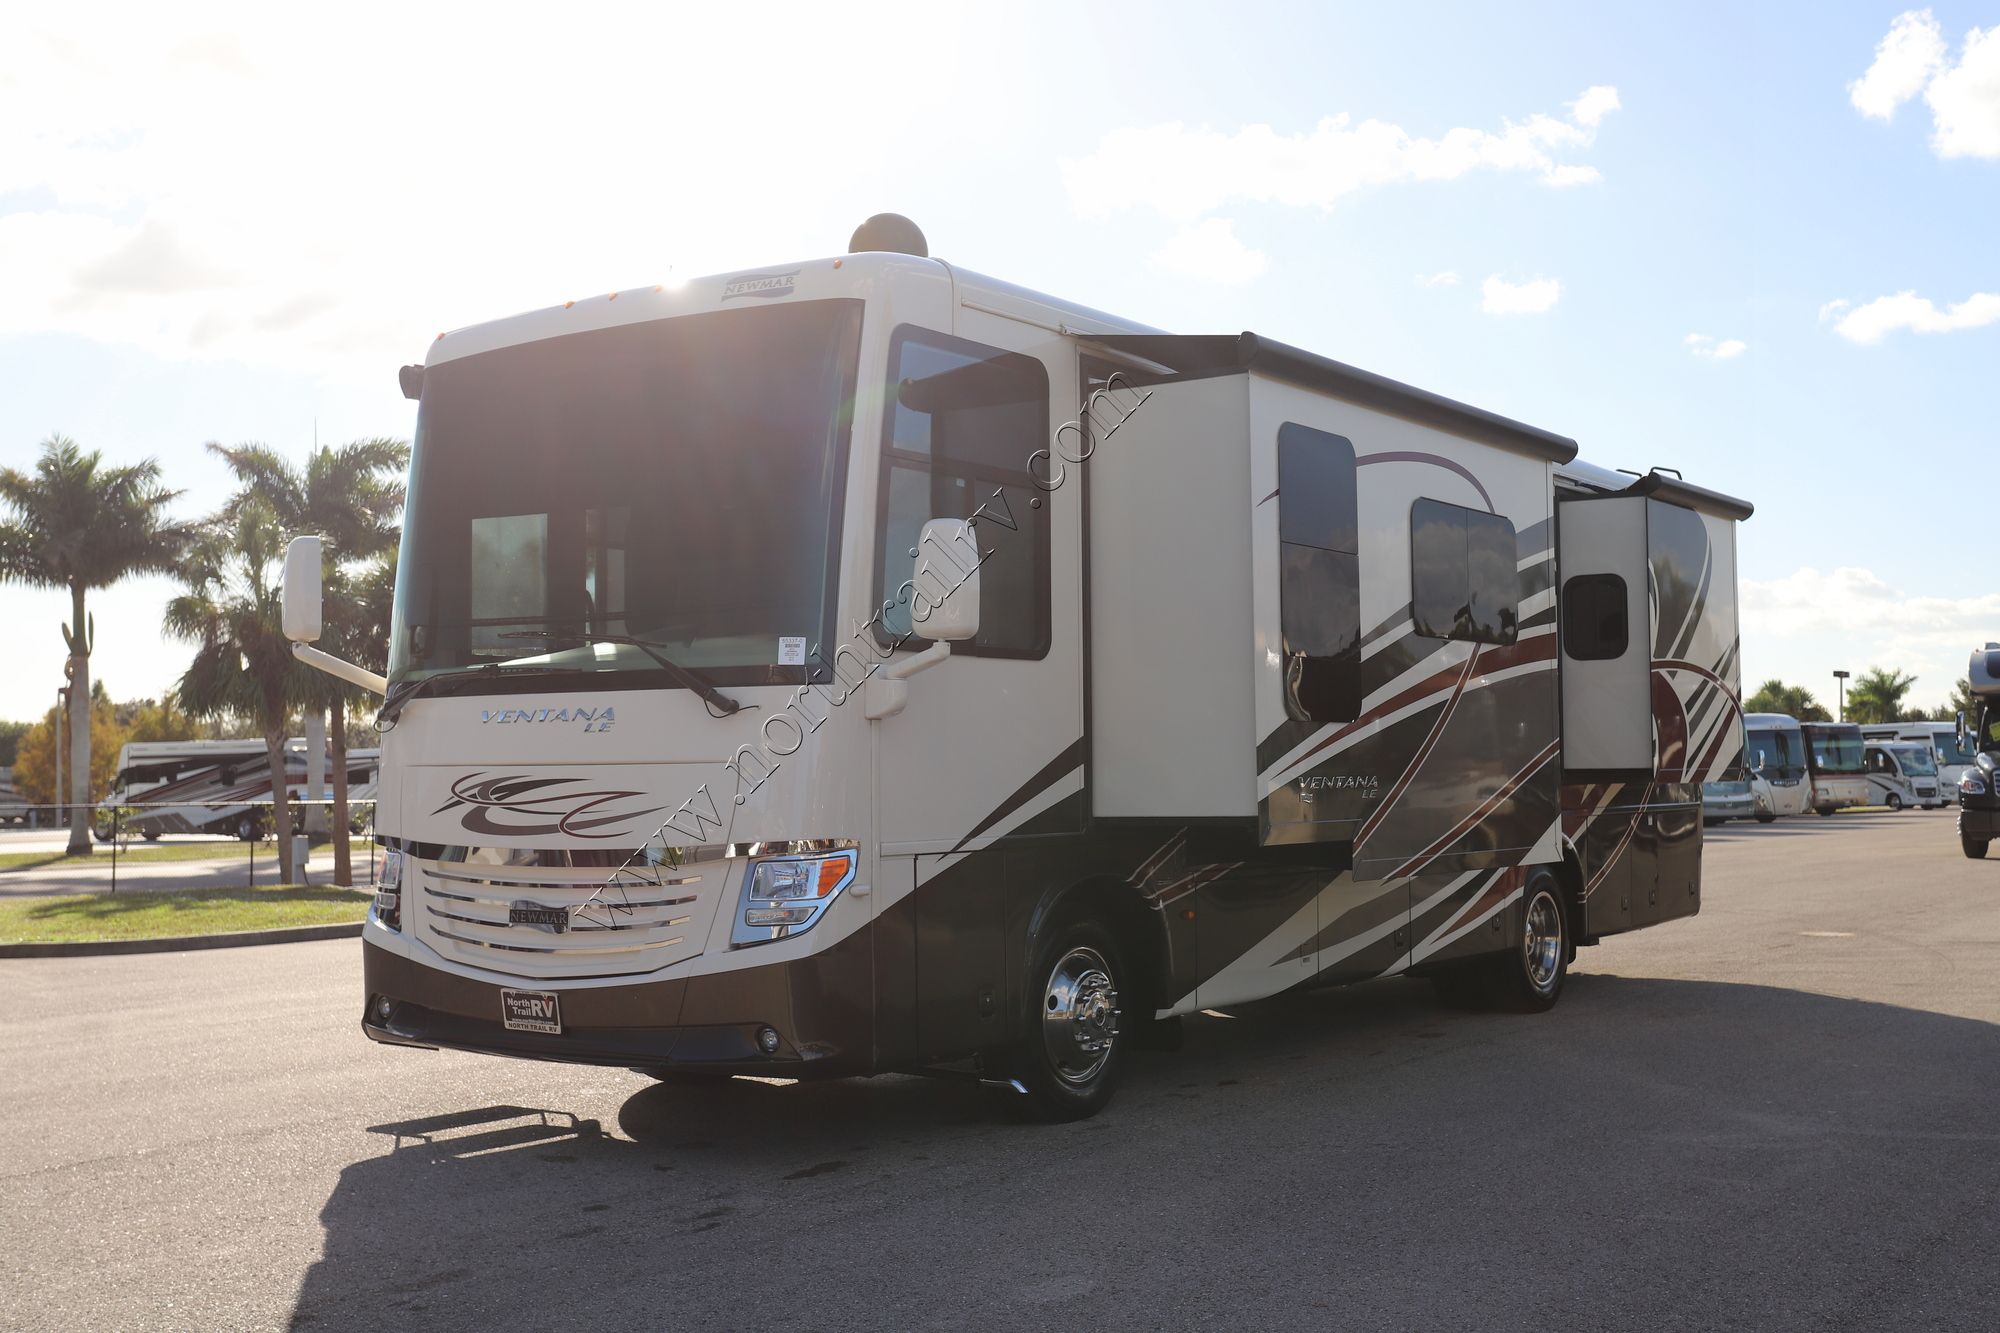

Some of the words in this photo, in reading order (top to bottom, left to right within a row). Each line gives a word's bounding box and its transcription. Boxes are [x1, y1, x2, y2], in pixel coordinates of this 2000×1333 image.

[724, 276, 796, 295] NEWMAR
[481, 707, 615, 724] VENTANA
[584, 722, 616, 733] LE
[1298, 776, 1378, 789] VENTANA
[1362, 789, 1378, 799] LE
[510, 911, 567, 924] NEWMAR
[507, 997, 530, 1008] North
[530, 999, 554, 1018] RV
[512, 1006, 531, 1016] Trail
[508, 1022, 529, 1030] NORTH
[530, 1024, 548, 1032] TRAIL
